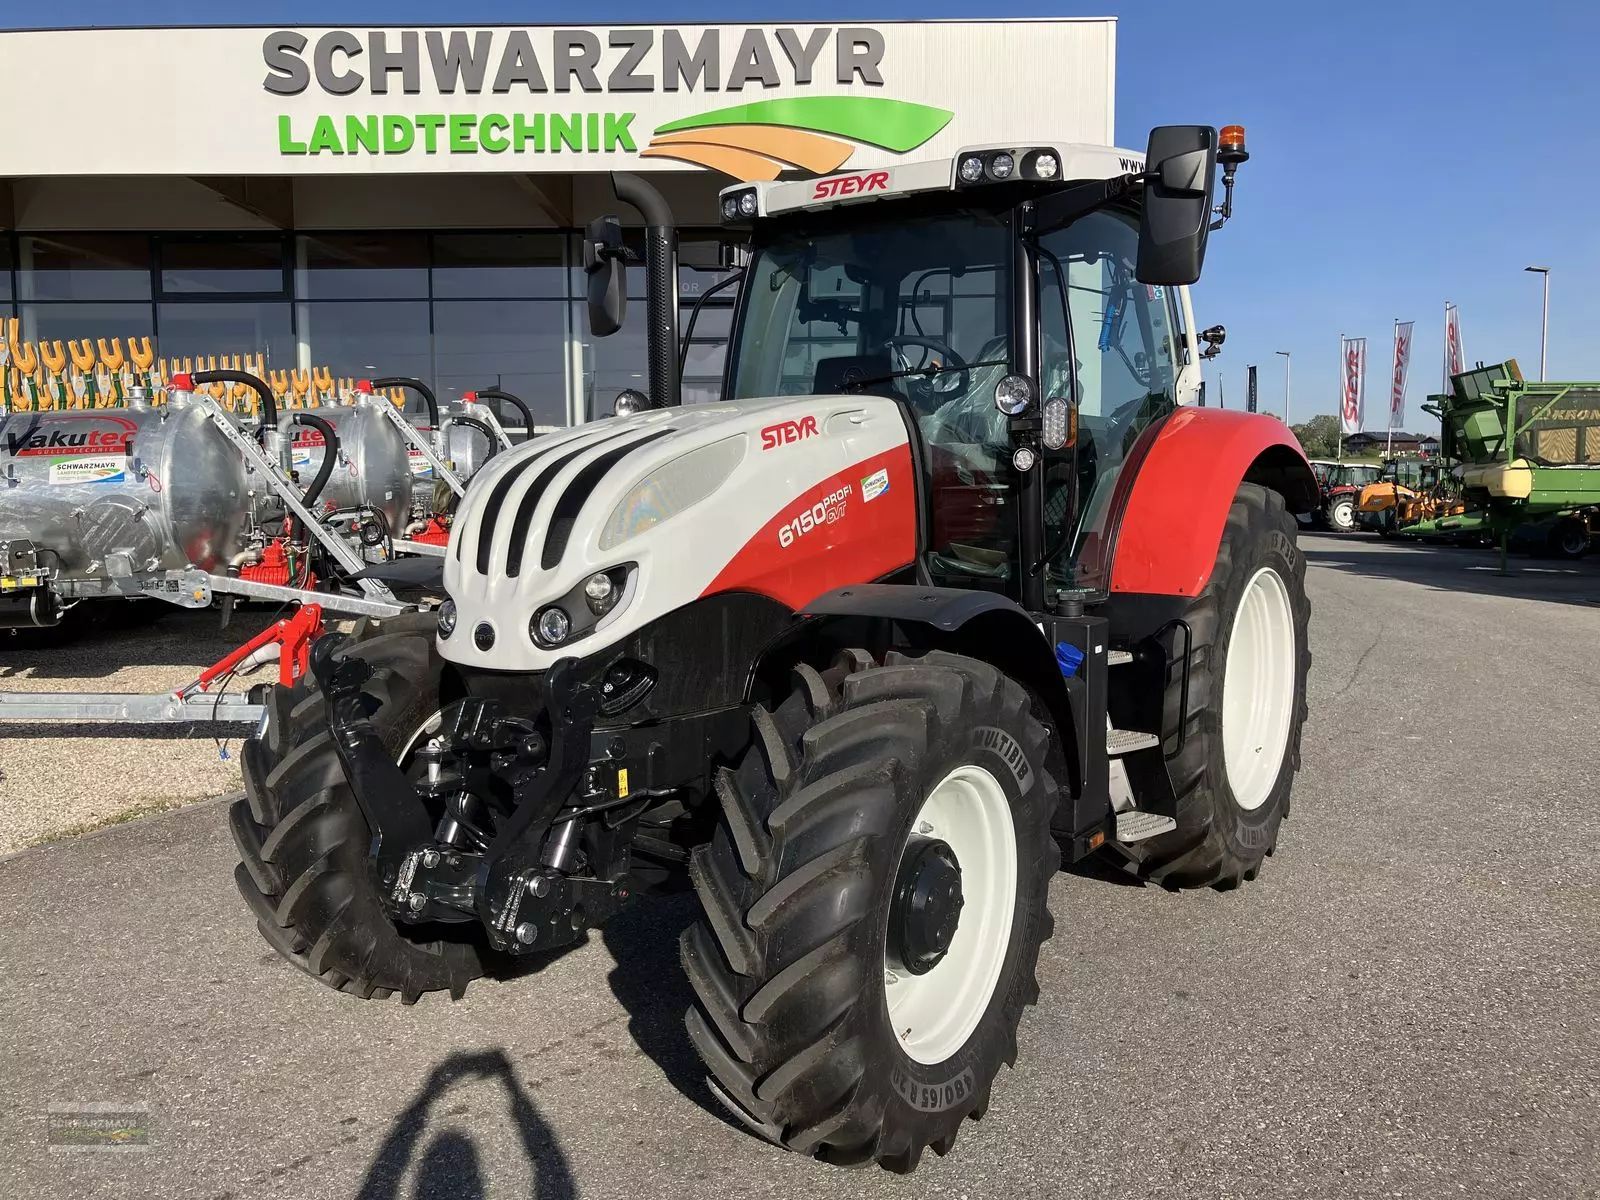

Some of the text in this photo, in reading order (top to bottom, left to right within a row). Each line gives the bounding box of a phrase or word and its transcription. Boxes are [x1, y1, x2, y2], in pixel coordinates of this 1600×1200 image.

[263, 27, 886, 96] SCHWARZMAYR
[278, 112, 638, 154] LANDTECHNIK
[812, 171, 889, 200] STEYR
[1344, 348, 1359, 424] STEYR
[1391, 336, 1407, 415] STEYR
[7, 426, 138, 457] Vakutec
[760, 415, 819, 451] STEYR
[57, 462, 116, 471] SCHWARZMAYR
[778, 484, 853, 548] 6150 PROFI
[826, 501, 847, 524] CVT
[974, 729, 1029, 781] MULTIBIB
